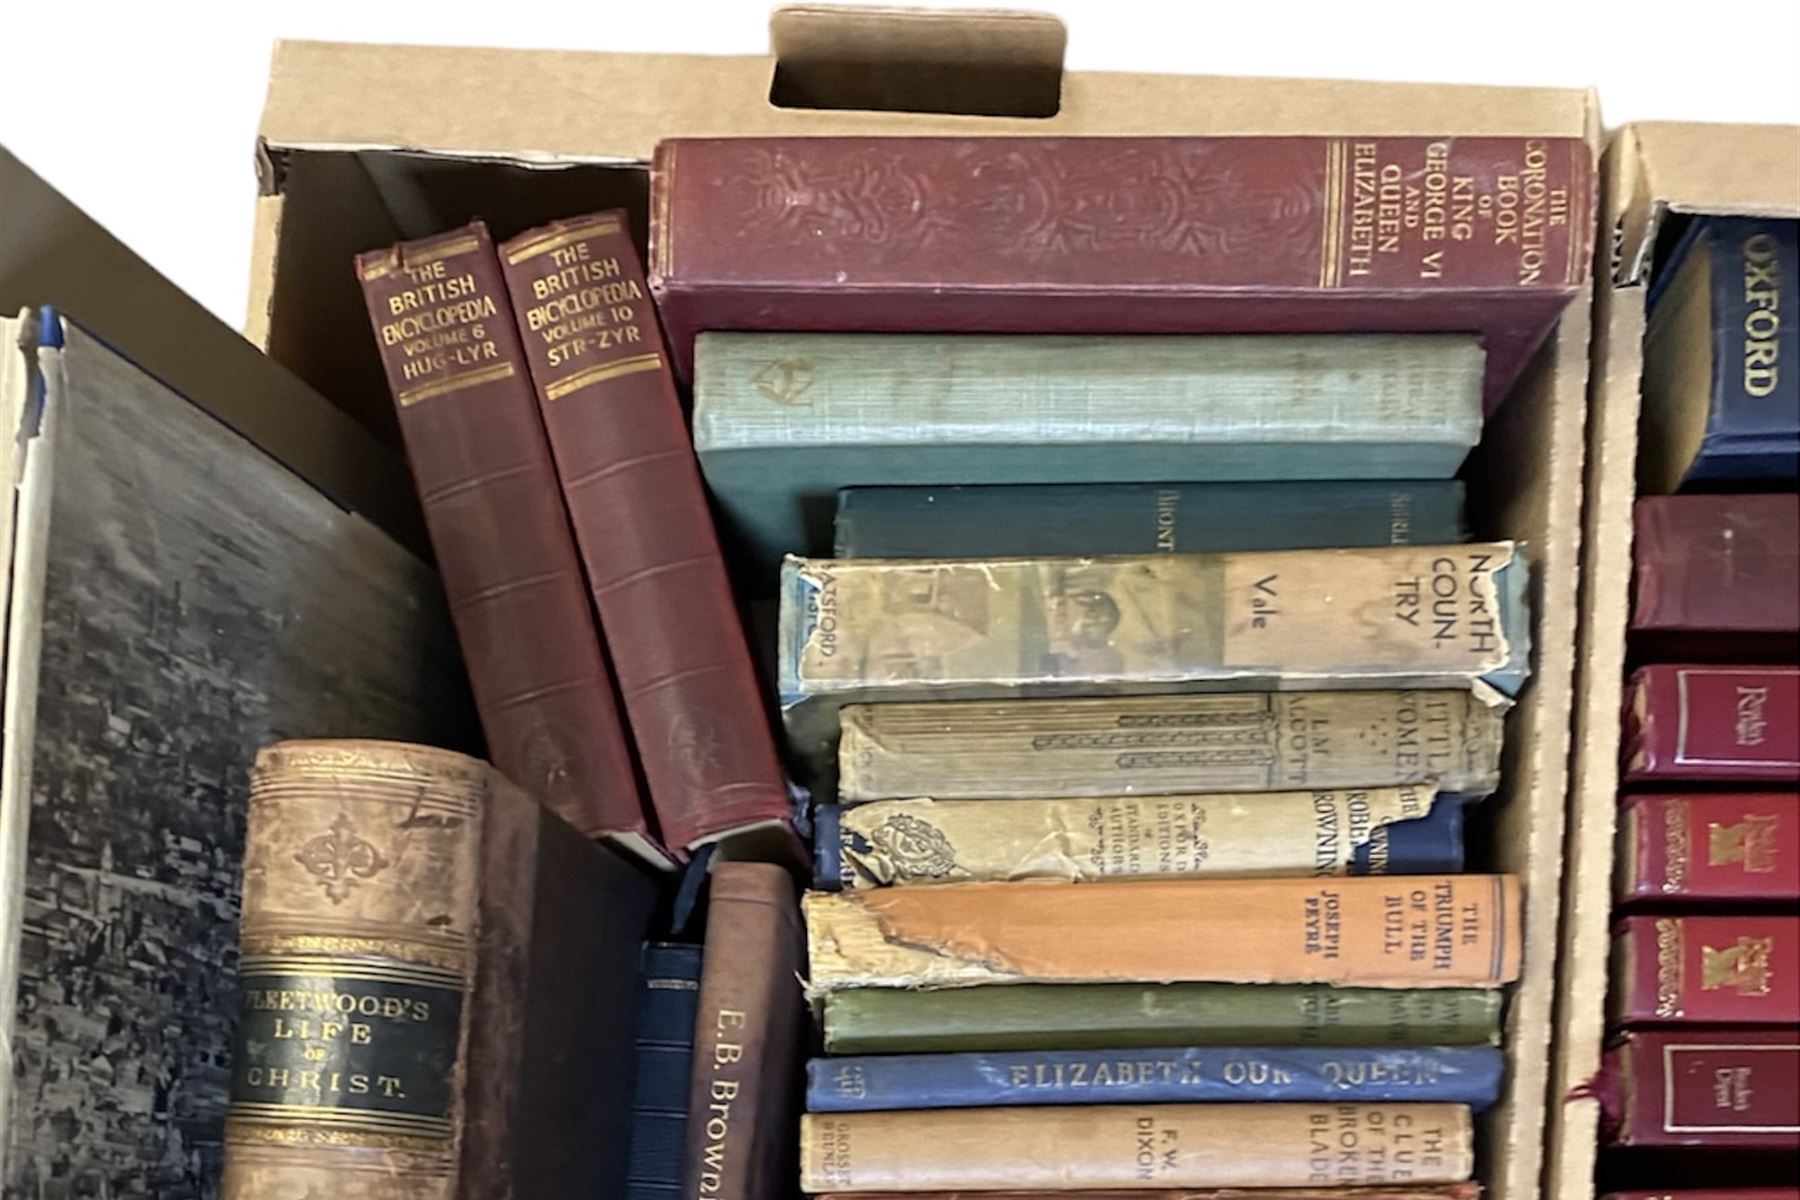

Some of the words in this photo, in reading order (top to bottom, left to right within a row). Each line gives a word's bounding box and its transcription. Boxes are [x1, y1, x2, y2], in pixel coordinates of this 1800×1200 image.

[1349, 143, 1376, 276] ELIZABETH
[1379, 165, 1401, 252] QUEEN
[1404, 187, 1420, 228] AND
[1423, 142, 1448, 240] GEORGE
[1451, 177, 1473, 240] KING
[1478, 195, 1492, 218] OF
[1495, 176, 1518, 244] BOOK
[1549, 188, 1567, 225] THE
[1519, 141, 1546, 285] CORONATION
[410, 261, 446, 283] THE
[551, 243, 589, 266] THE
[1421, 251, 1442, 278] VI
[389, 275, 476, 315] BRITISH
[533, 259, 619, 300] BRITISH
[382, 296, 497, 346] ENCYCLOPEDIA
[527, 280, 642, 331] ENCYCLOPEDIA
[542, 316, 605, 343] VOLUME
[612, 307, 633, 323] 10
[1744, 233, 1780, 397] OXFORD
[402, 341, 498, 380] HUG-LYR
[403, 328, 467, 357] VOLUME
[472, 325, 485, 339] 6
[548, 328, 640, 366] STR-ZYR
[1252, 575, 1278, 628] Vale
[1395, 576, 1420, 626] TRY
[1432, 558, 1458, 649] COUN-
[1411, 890, 1425, 911] OF
[1321, 891, 1341, 959] JOSEPH
[1384, 895, 1402, 954] BULL
[1410, 922, 1428, 961] THE
[1434, 880, 1452, 970] TRIUMPH
[1462, 903, 1479, 945] THE
[274, 1019, 372, 1044] LIFE
[304, 1047, 327, 1061] OF
[247, 1066, 405, 1099] CHRIST.
[1009, 1061, 1200, 1088] ELIZABETH
[1222, 1061, 1293, 1085] OUR
[1161, 1130, 1177, 1144] F.
[1367, 1112, 1385, 1136] OF
[1136, 1117, 1153, 1180] DIXON
[1161, 1149, 1177, 1169] W.
[1309, 1114, 1328, 1182] BLADE
[1367, 1148, 1385, 1183] THE
[1392, 1115, 1413, 1180] CLUE
[1422, 1128, 1442, 1167] THE
